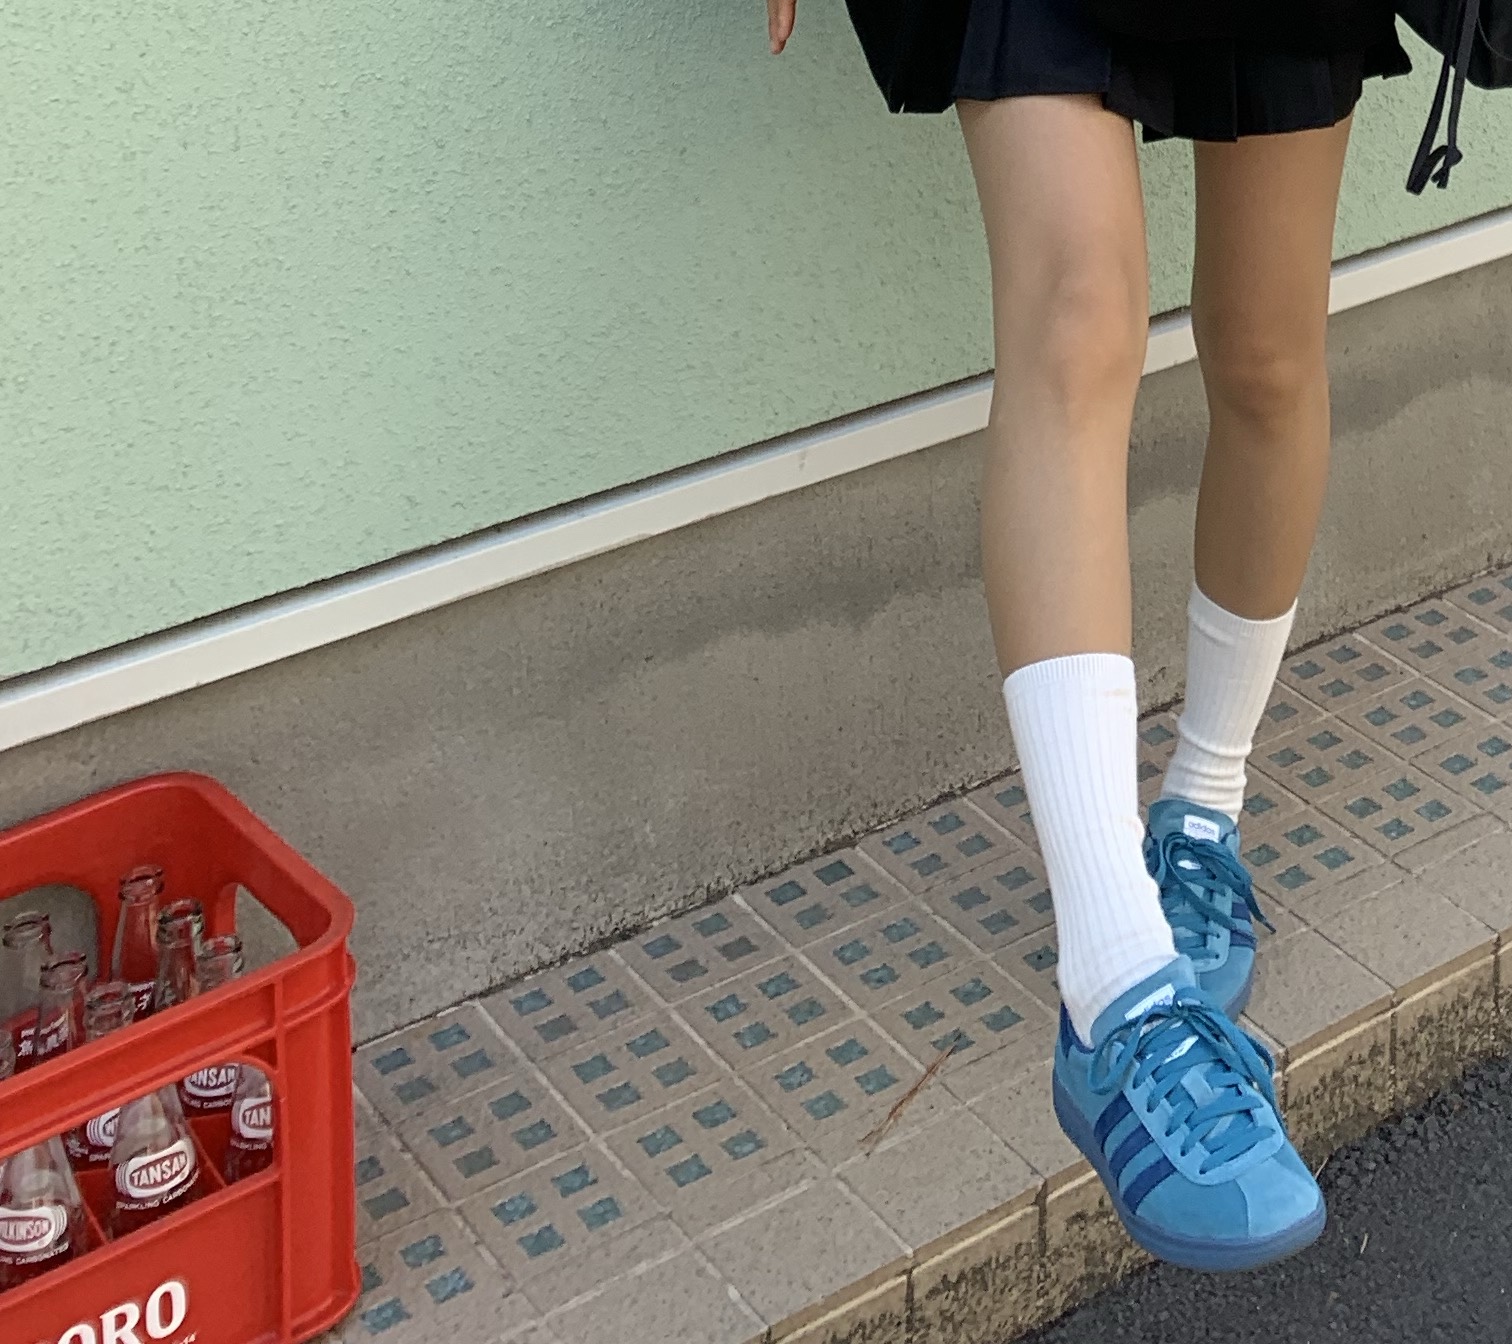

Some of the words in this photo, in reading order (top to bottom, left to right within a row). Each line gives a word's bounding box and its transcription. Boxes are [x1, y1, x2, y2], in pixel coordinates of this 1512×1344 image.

[189, 1066, 236, 1087] ANSAN
[244, 1105, 272, 1126] TAN
[131, 1153, 187, 1187] TANSAN
[0, 1219, 50, 1241] ILKINSON
